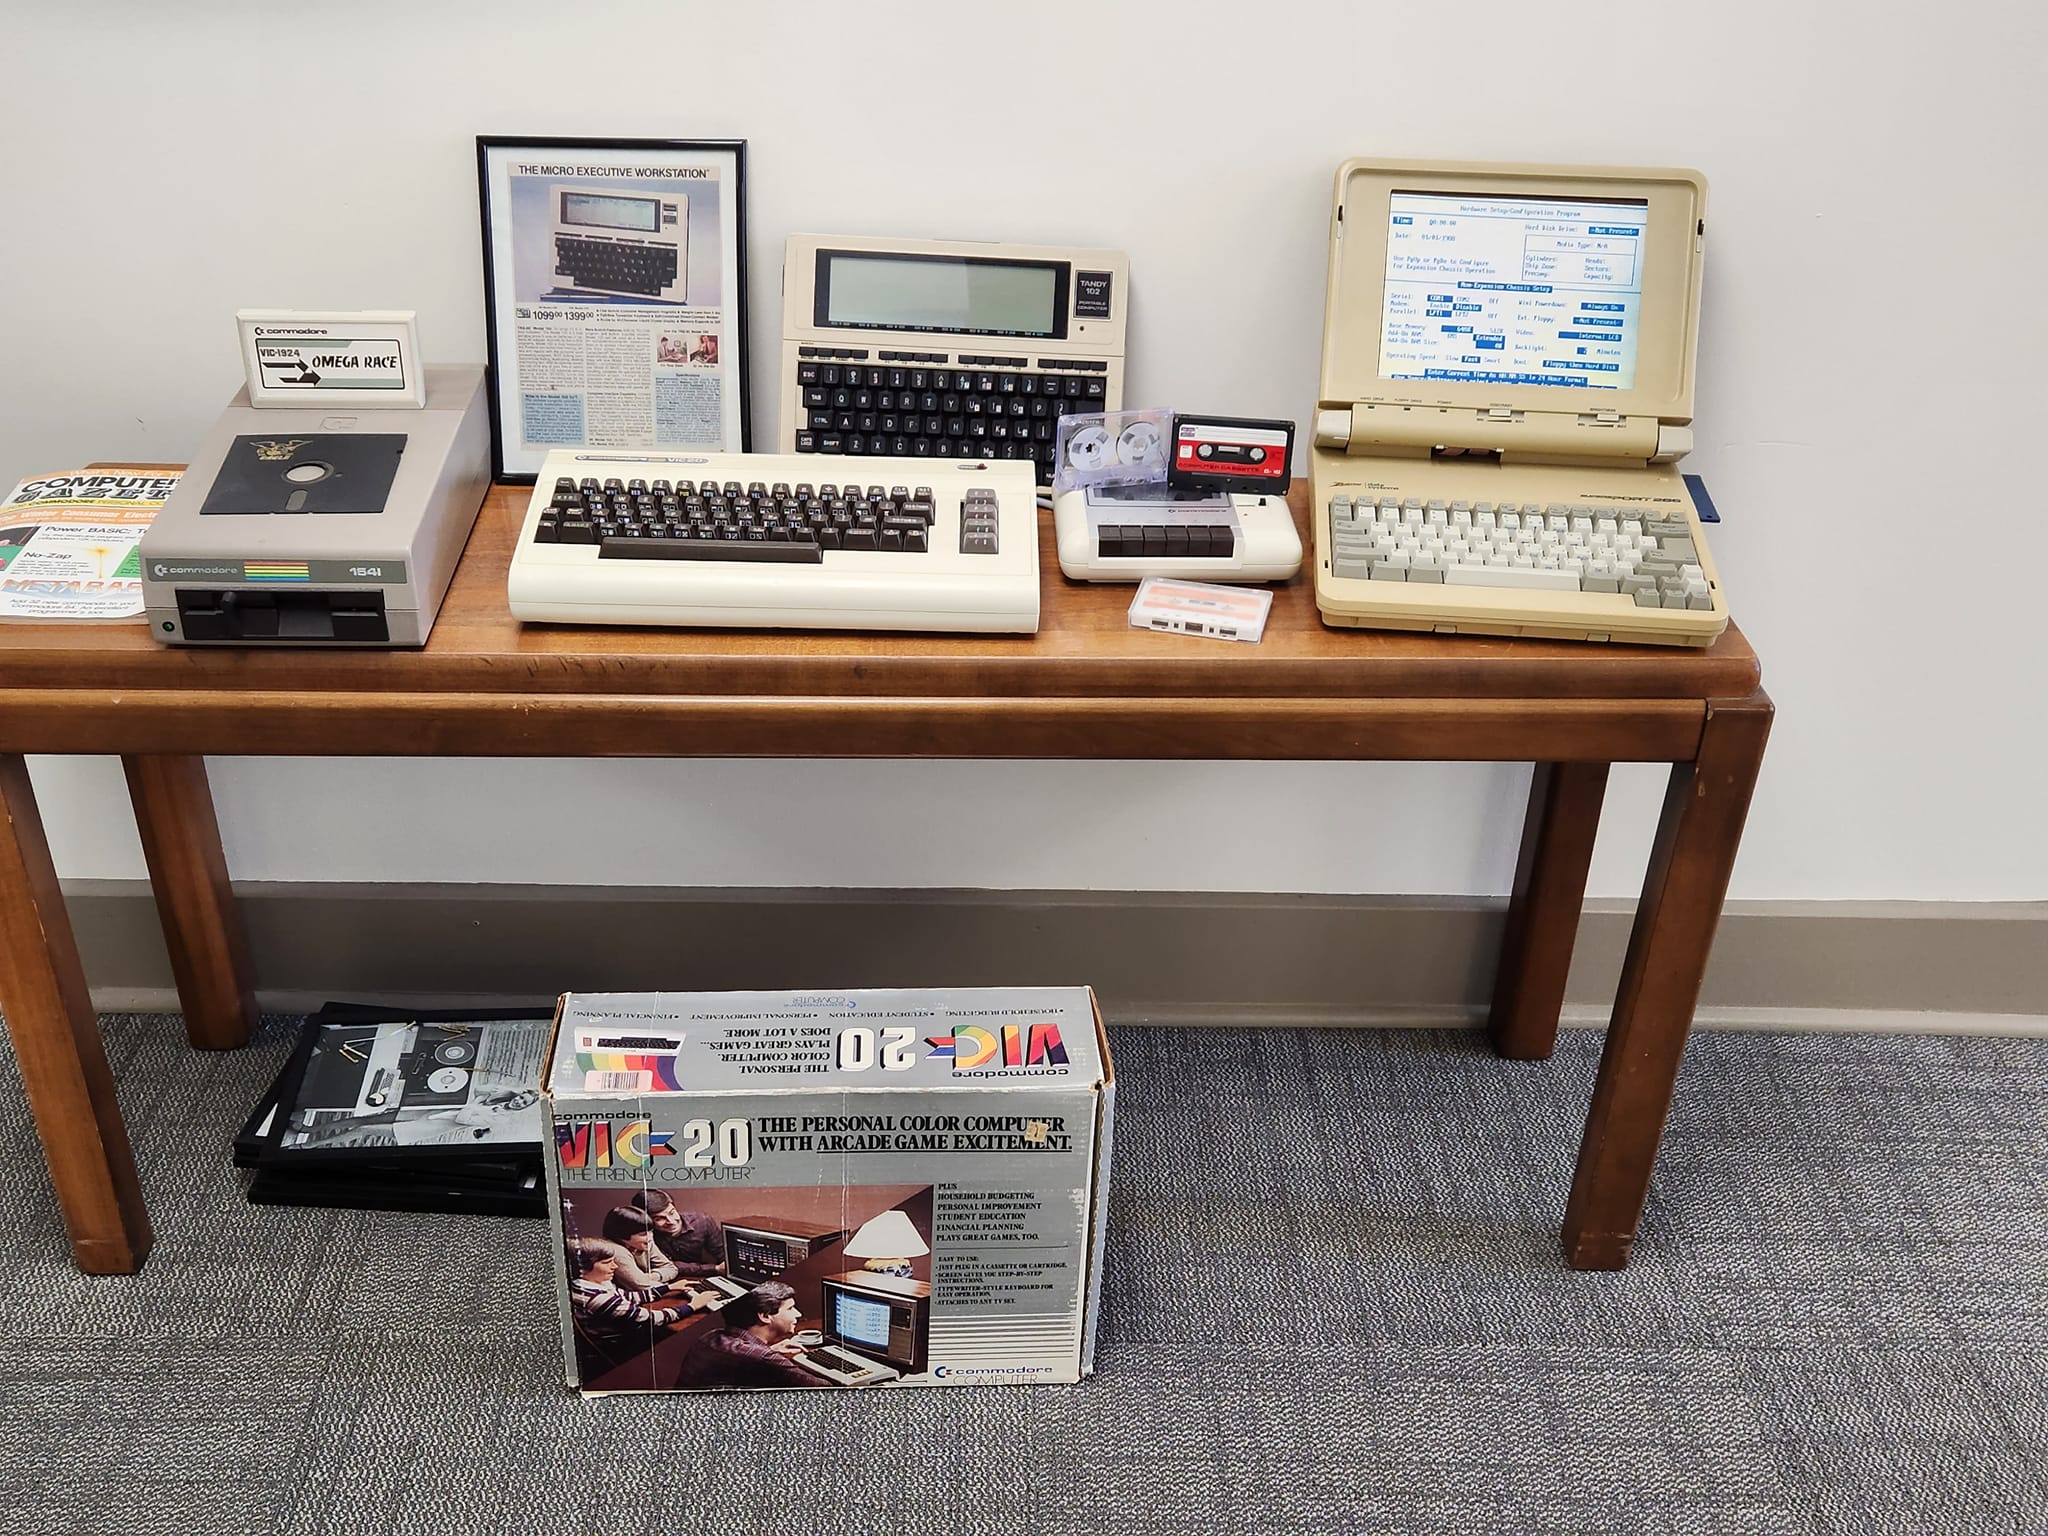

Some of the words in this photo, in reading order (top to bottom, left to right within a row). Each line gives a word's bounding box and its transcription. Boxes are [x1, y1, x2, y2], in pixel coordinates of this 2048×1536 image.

[518, 165, 538, 174] THE
[541, 166, 574, 176] MICRO
[577, 167, 632, 177] EXECUTIVE
[635, 168, 708, 178] WORKSTATION
[1557, 210, 1581, 218] Program
[1080, 280, 1107, 288] TANDY
[260, 348, 300, 358] VIC-1924
[312, 356, 359, 369] OMEGA
[364, 356, 398, 369] RACE
[62, 510, 121, 519] Consumer
[24, 552, 72, 560] No-Zap
[170, 566, 238, 574] commodore
[349, 567, 382, 577] 1541
[572, 1011, 622, 1019] PLANNING
[724, 1029, 761, 1038] MORE.
[764, 1028, 786, 1037] LOT
[790, 1028, 798, 1036] A
[801, 1028, 831, 1036] DOES
[753, 1040, 792, 1049] GREAT
[795, 1040, 830, 1049] PLAYS
[836, 1026, 917, 1072] 20
[718, 1053, 788, 1062] COMPUTER.
[791, 1052, 831, 1061] COLOR
[739, 1065, 801, 1074] PERSONAL
[804, 1064, 830, 1073] THE
[952, 1069, 1069, 1079] commodore
[554, 1111, 651, 1121] commodore
[758, 1117, 797, 1133] THE
[802, 1116, 897, 1132] PERSONAL
[900, 1116, 961, 1132] COLOR
[683, 1118, 753, 1168] 20
[758, 1136, 813, 1152] WITH
[817, 1134, 891, 1151] ARCADE
[895, 1134, 949, 1150] GAME
[567, 1168, 591, 1181] THE
[661, 1167, 752, 1181] COMPUTER
[938, 1192, 987, 1201] HOUSEHOLD
[987, 1192, 1035, 1200] BUDGETING
[937, 1203, 980, 1211] PERSONAL
[981, 1202, 1042, 1210] IMPROVEMENT
[936, 1213, 977, 1221] STUDENT
[978, 1212, 1027, 1220] EDUCATION
[956, 1366, 1053, 1375] commodore
[953, 1374, 1039, 1385] COMPUTER
